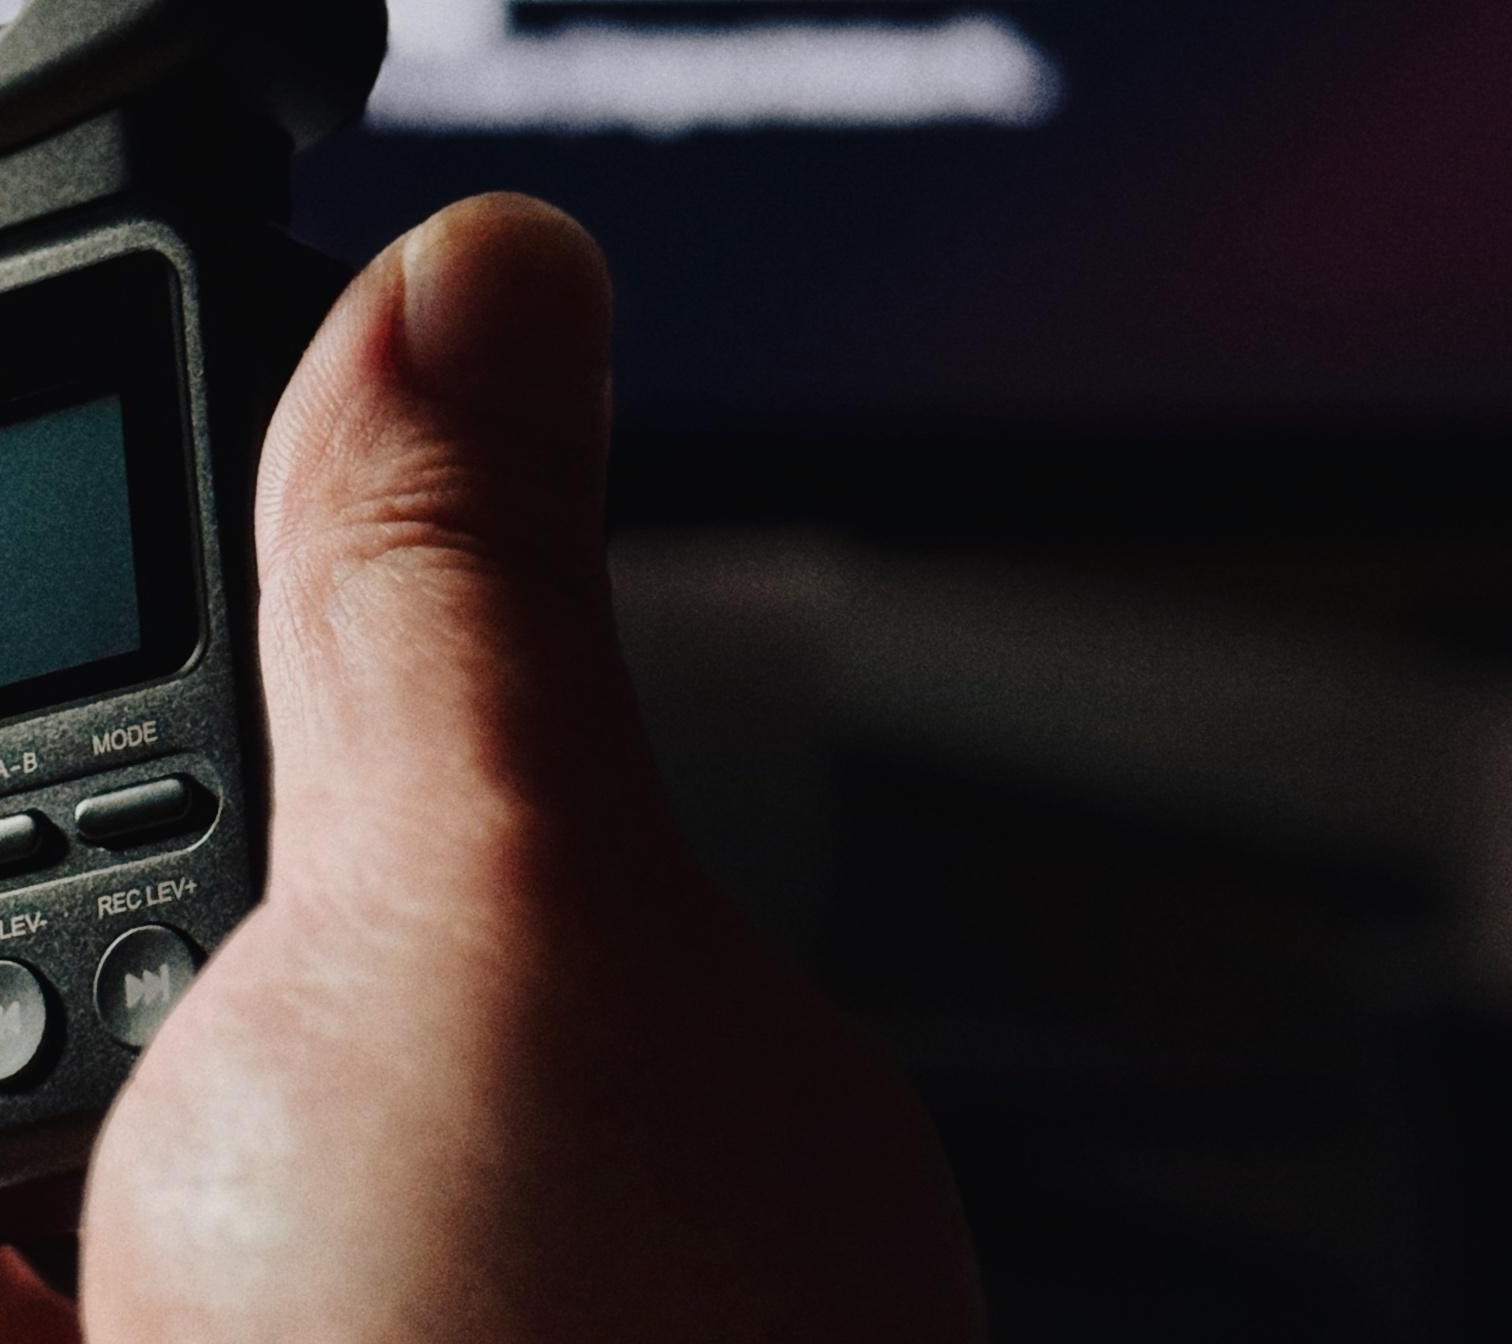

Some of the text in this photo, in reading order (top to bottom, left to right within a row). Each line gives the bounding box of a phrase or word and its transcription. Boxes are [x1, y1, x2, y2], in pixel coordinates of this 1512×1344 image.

[92, 720, 159, 755] MODE
[97, 877, 199, 919] REC LEV+
